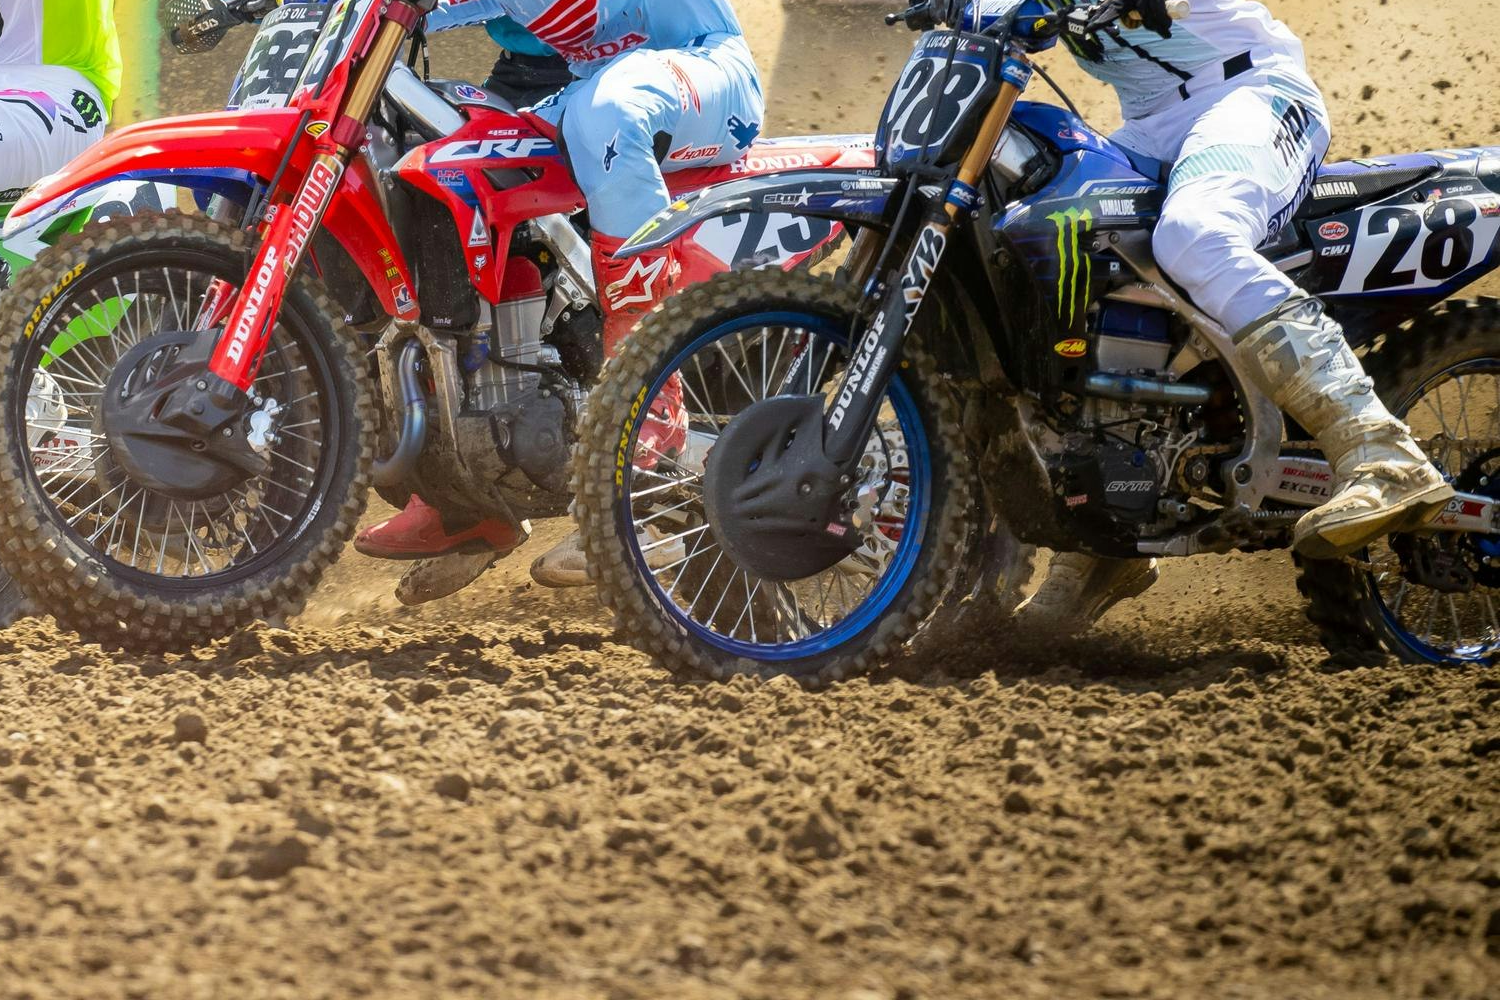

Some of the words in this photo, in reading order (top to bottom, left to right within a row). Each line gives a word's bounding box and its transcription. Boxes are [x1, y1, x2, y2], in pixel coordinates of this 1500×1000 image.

[926, 37, 951, 49] LUCAS
[886, 58, 984, 148] 28
[428, 138, 557, 164] CRF
[730, 151, 822, 175] HONDA
[849, 181, 884, 191] YAMAHA
[1445, 184, 1474, 195] CRAIG
[1099, 199, 1137, 216] YAMALUBE
[1363, 198, 1478, 293] 28
[23, 261, 87, 339] DUNLOP
[226, 246, 280, 366] DUNLOP
[828, 311, 888, 432] DUNLOP
[861, 345, 888, 397] BRAKING
[615, 385, 649, 489] DUNLOP
[1105, 480, 1154, 493] GYTR
[1278, 480, 1333, 498] EXCEL
